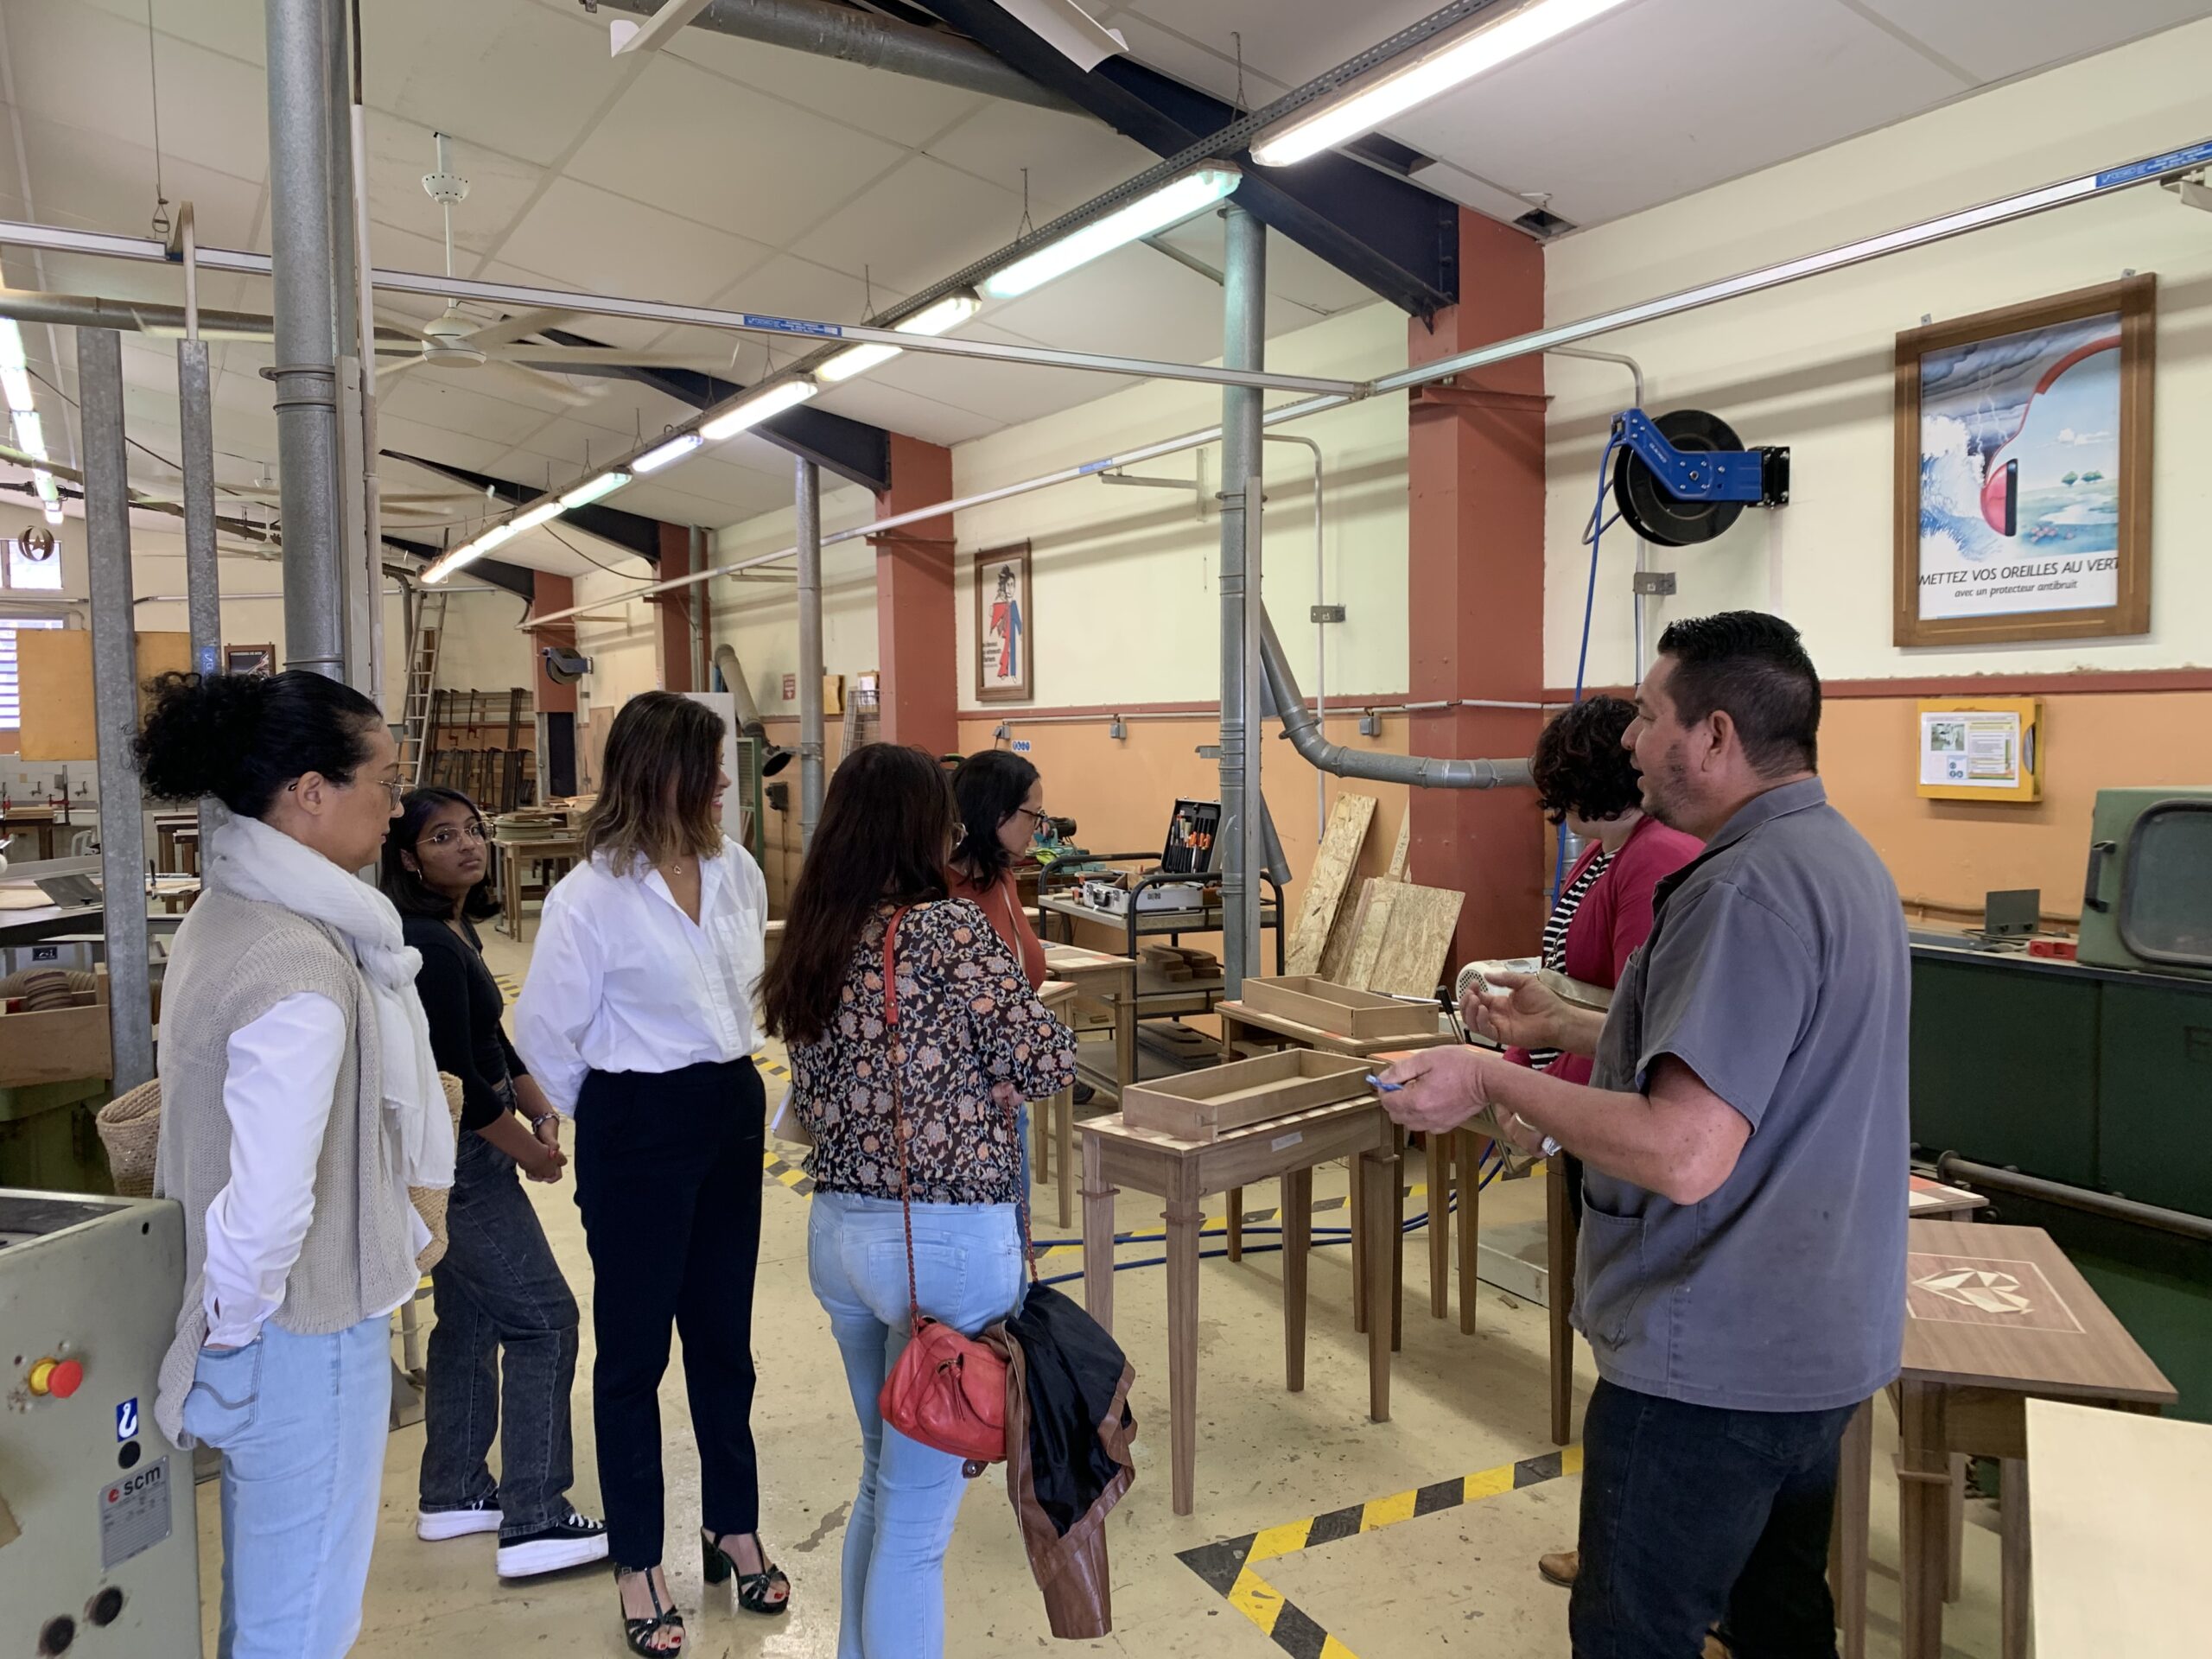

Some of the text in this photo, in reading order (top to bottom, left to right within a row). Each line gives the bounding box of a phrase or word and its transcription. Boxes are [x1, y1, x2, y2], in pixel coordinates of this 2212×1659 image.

[1917, 556, 2120, 586] METTEZ VOS OREILLES AU VERT
[1955, 589, 1974, 598] avec
[1989, 584, 2036, 598] protecteur
[2037, 580, 2079, 591] antibruit
[124, 1466, 161, 1496] scm
